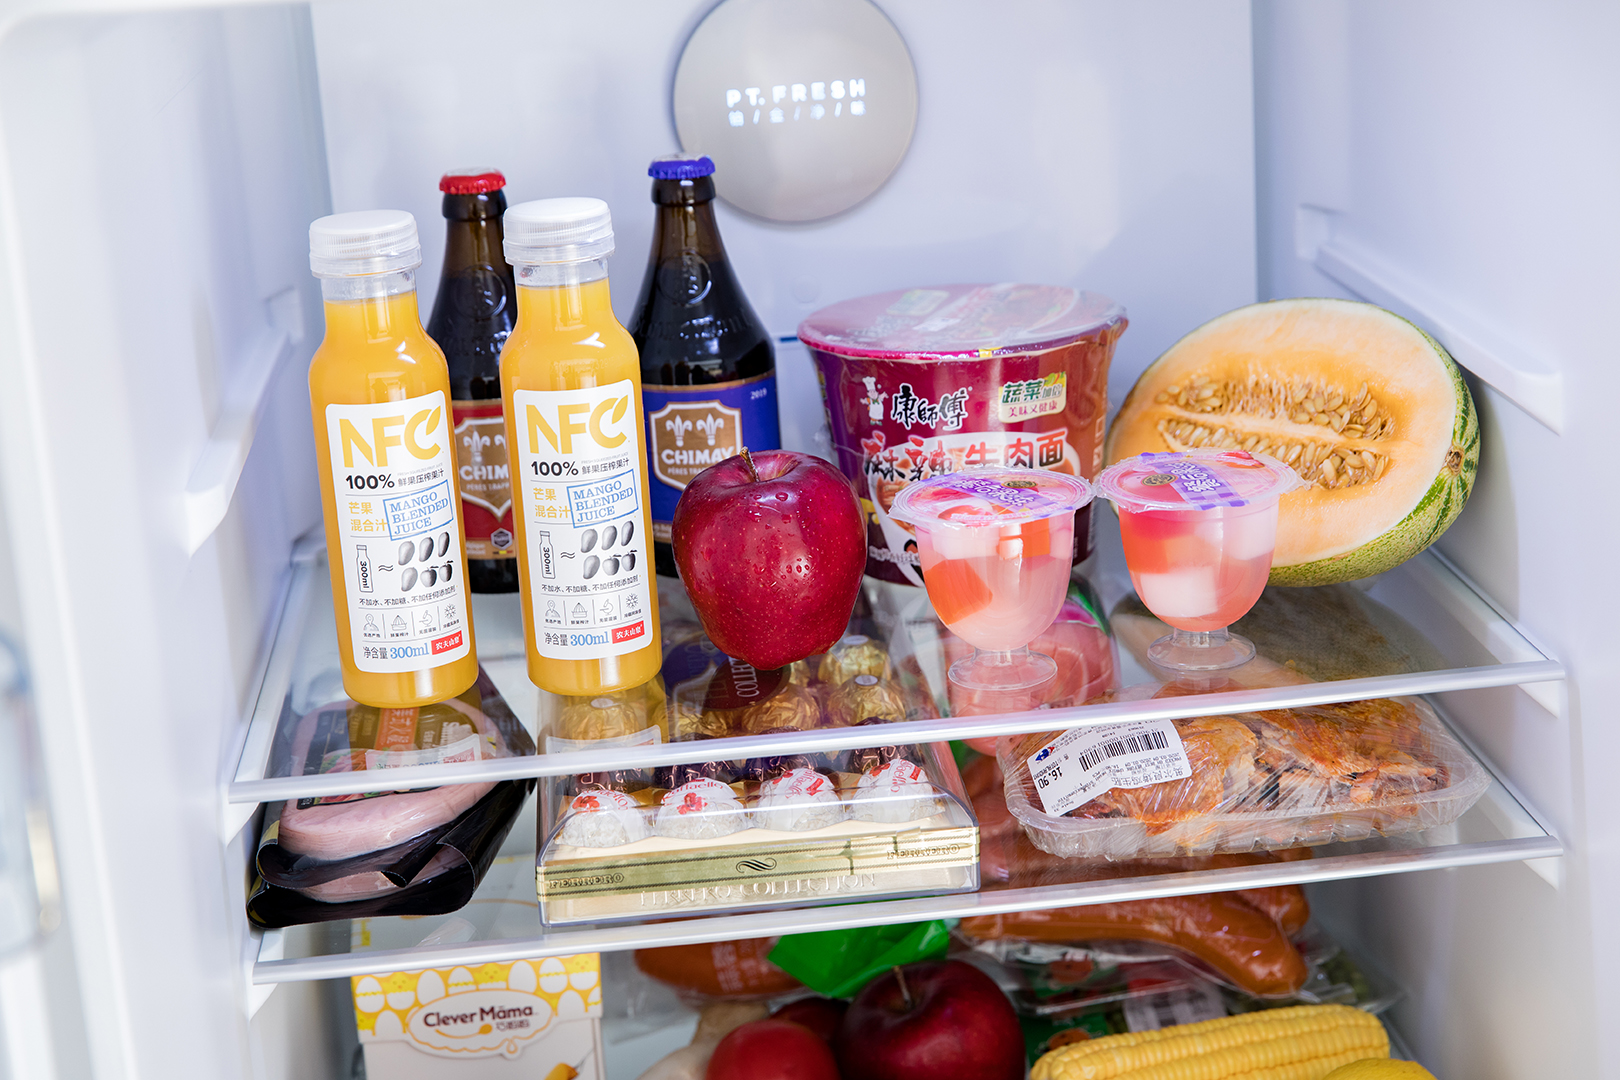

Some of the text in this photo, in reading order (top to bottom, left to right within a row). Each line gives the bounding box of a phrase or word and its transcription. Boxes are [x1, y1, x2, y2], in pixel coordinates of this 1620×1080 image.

[1009, 400, 1058, 418] 美味又健康
[526, 394, 628, 454] NFC
[339, 405, 441, 468] NFC
[661, 446, 735, 465] CHIMAY
[531, 460, 579, 476] 100%
[581, 457, 630, 475] 鲜果压榨果汁
[345, 473, 395, 489] 100%
[573, 480, 622, 500] MANGO
[389, 491, 438, 513] MANGO
[533, 487, 557, 501] 芒果
[576, 487, 634, 511] BLENDED
[348, 502, 373, 515] 芒果
[392, 497, 449, 524] BLENDED
[534, 504, 571, 518] 混合汁
[577, 505, 615, 522] JUICE
[350, 519, 388, 532] 混合汁
[394, 516, 432, 535] JUICE
[543, 547, 552, 575] 300ml
[360, 560, 369, 589] 300ml
[544, 631, 610, 646] 净含量 300ml
[363, 643, 430, 660] 净含量 300ml
[1037, 766, 1062, 789] 16.90
[886, 844, 960, 860] FERRERO
[549, 873, 625, 889] FERRERO
[423, 1011, 477, 1028] Clever
